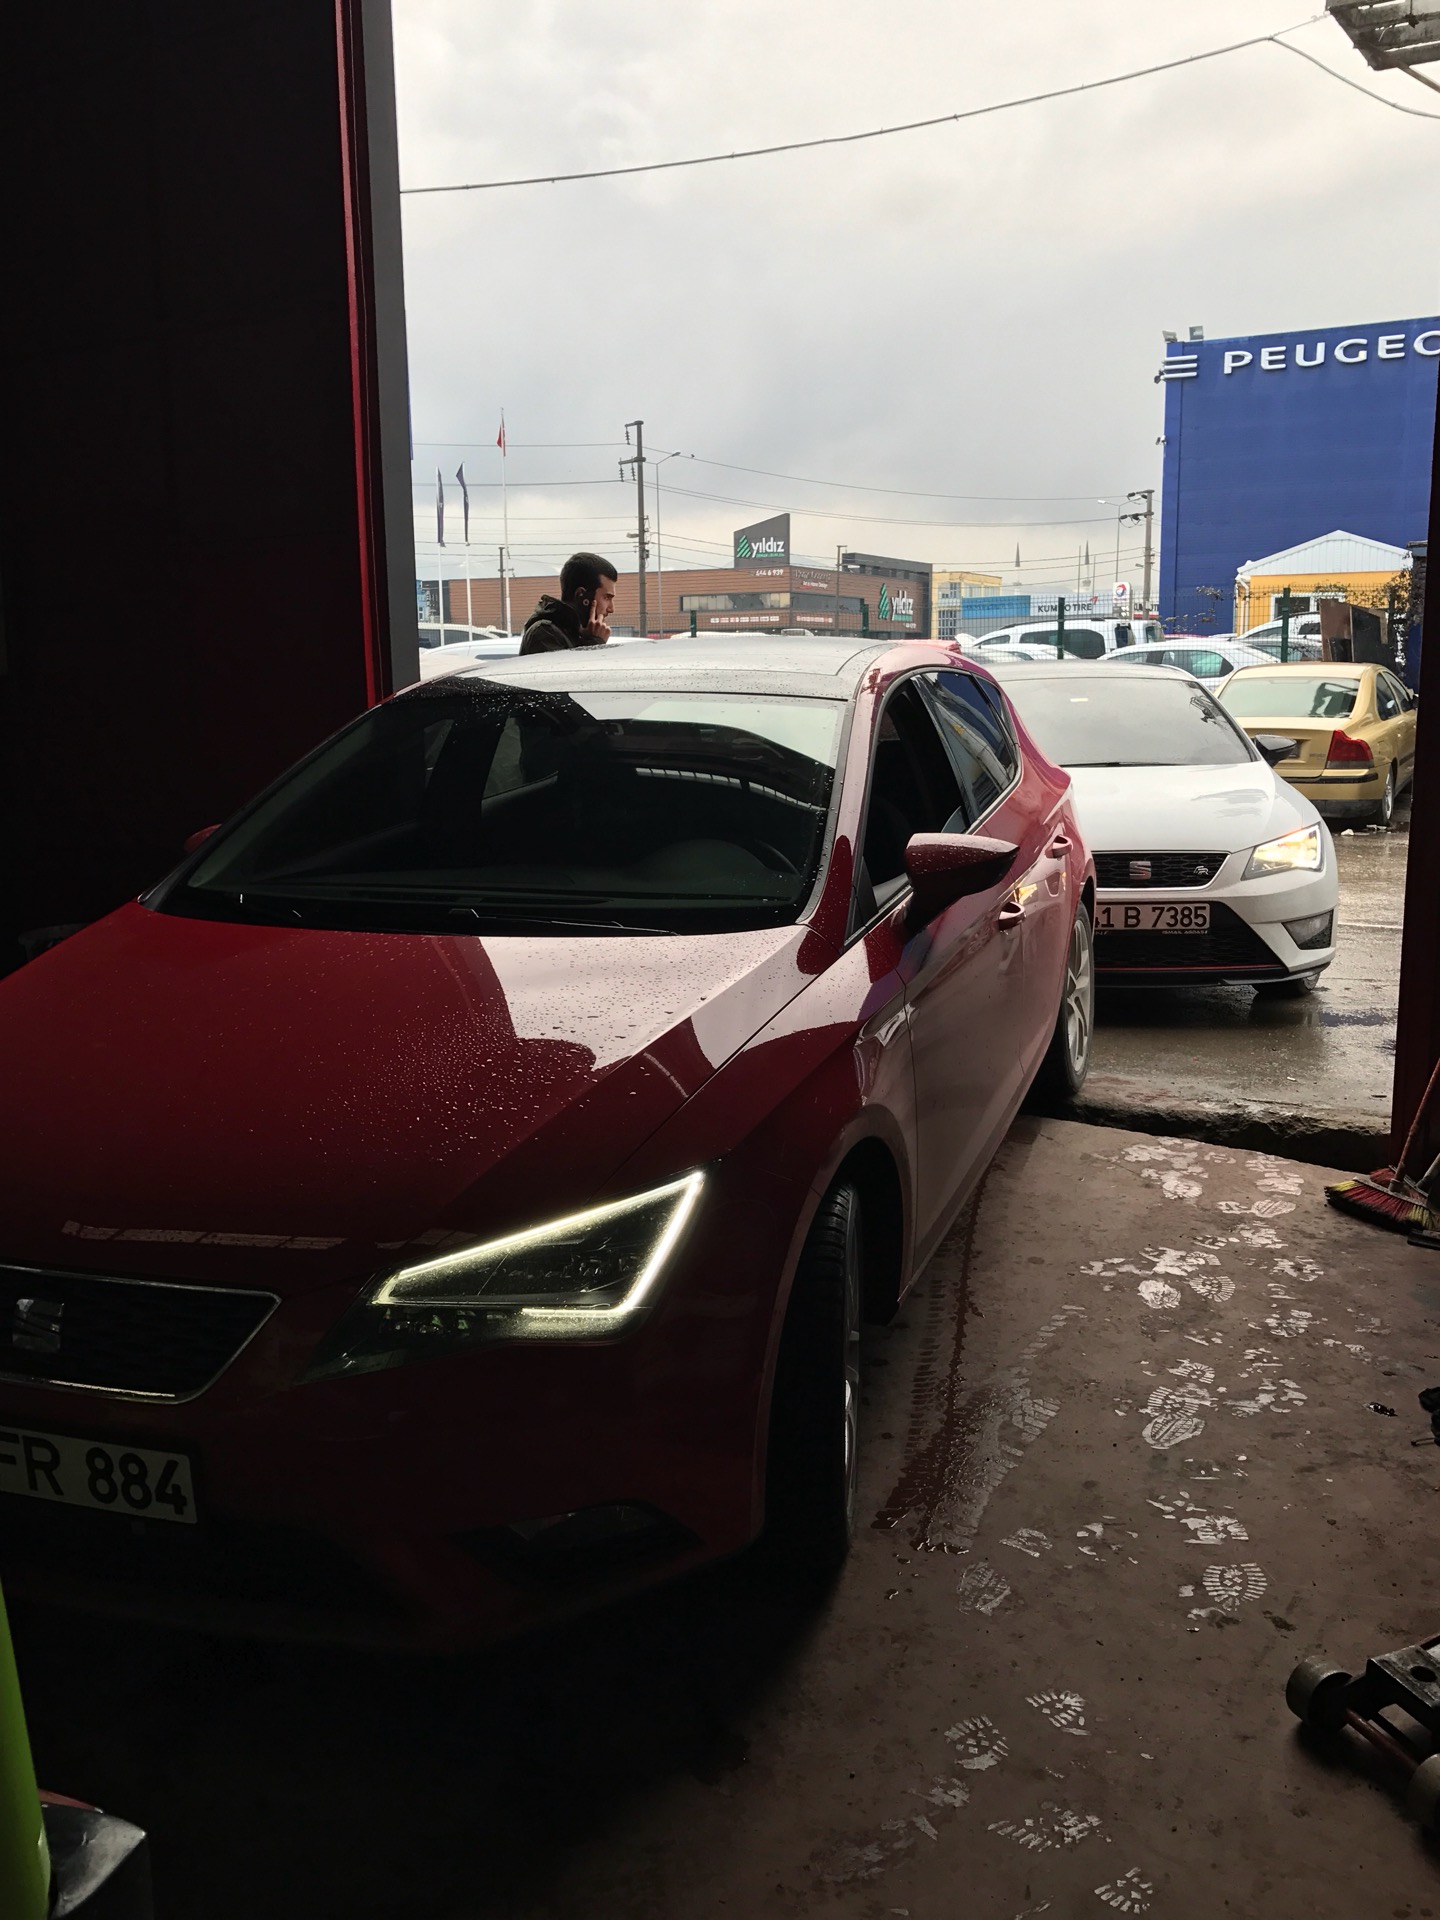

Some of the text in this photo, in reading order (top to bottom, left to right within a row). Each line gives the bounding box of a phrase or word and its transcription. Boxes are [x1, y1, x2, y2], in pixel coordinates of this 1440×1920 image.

[1038, 603, 1092, 612] KUMO TIRE
[1124, 907, 1141, 928] B
[1151, 906, 1207, 928] 7385
[86, 1447, 187, 1515] 884
